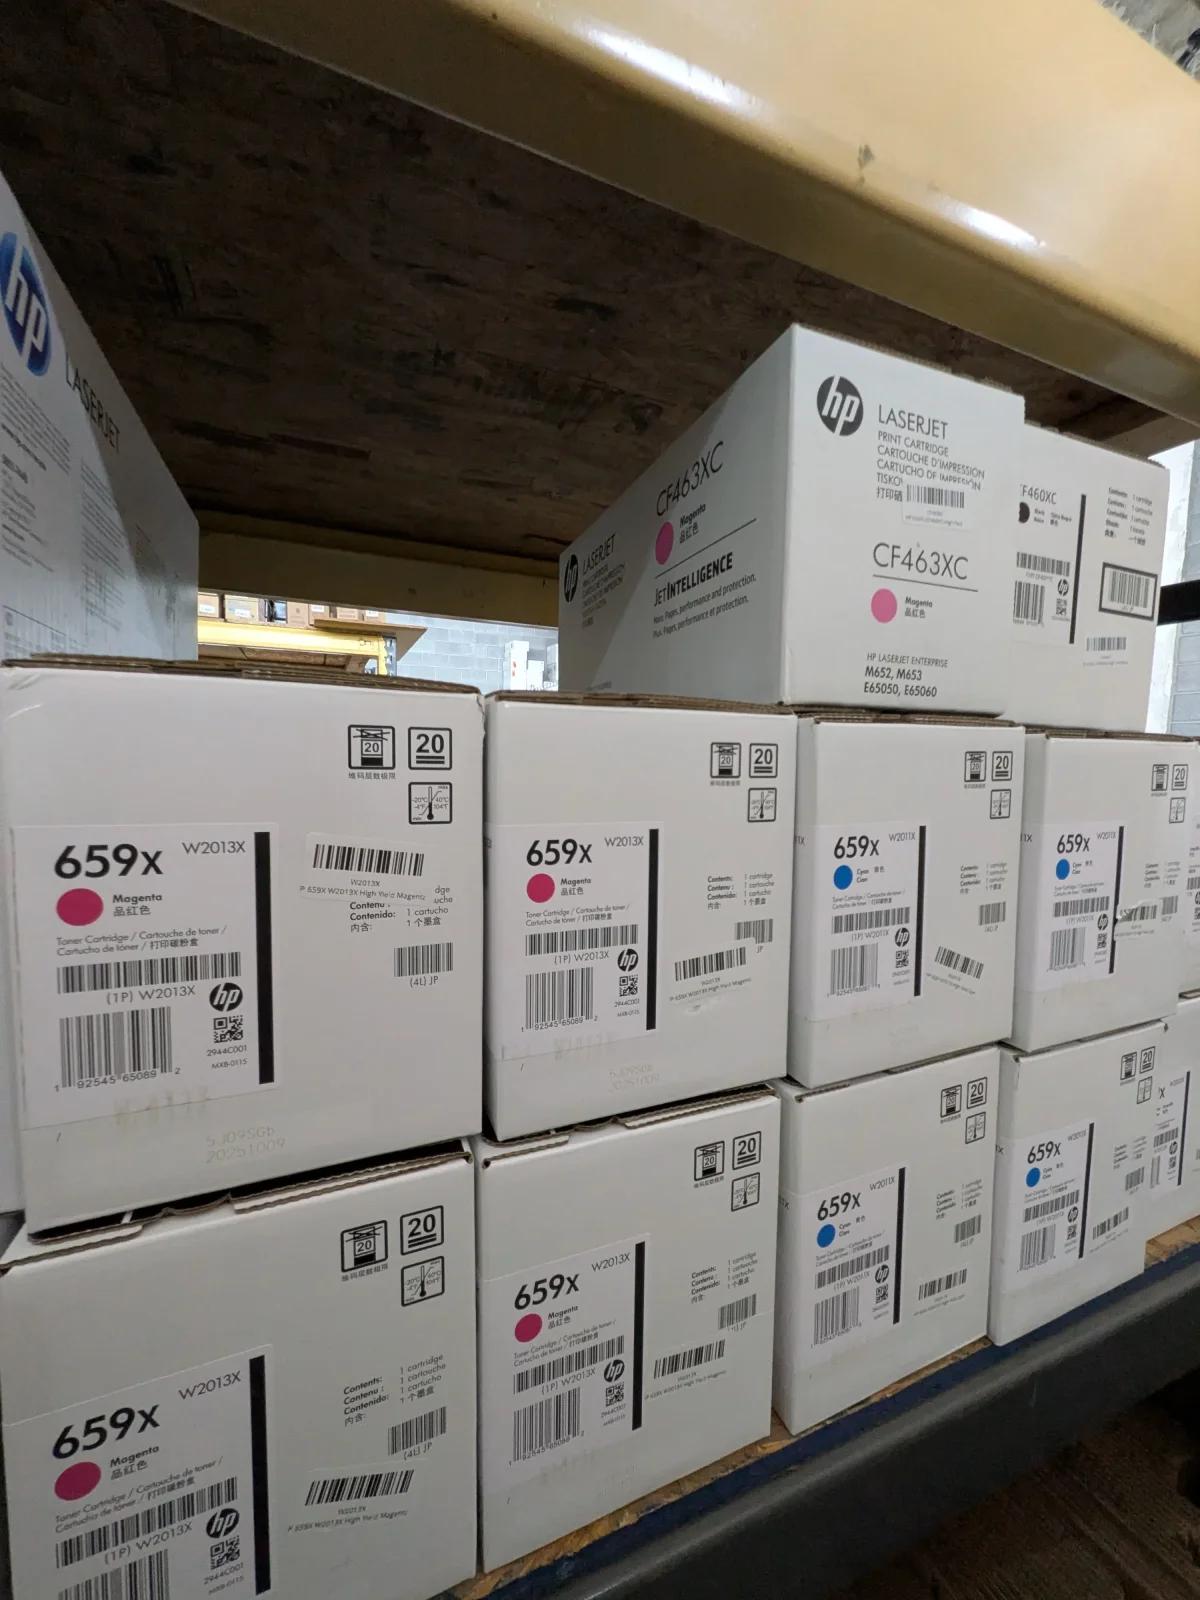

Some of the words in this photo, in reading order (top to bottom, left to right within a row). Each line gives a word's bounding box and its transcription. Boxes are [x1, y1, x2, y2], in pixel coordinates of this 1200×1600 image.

[65, 350, 121, 454] LASERJET
[816, 375, 864, 436] hp
[878, 403, 949, 441] LASERJET
[878, 430, 902, 446] PRINT
[903, 436, 949, 458] CARTRIDGE
[876, 458, 924, 479] CARTUCHO
[877, 445, 929, 468] CARTOUCHE
[931, 455, 985, 480] D'IMPRESSION
[656, 440, 724, 517] CF463XC
[1020, 484, 1057, 506] F460XC
[679, 502, 706, 528] Magenta
[582, 533, 616, 576] LASERJET
[872, 542, 969, 581] CF463XC
[904, 596, 933, 609] Magenta
[866, 651, 879, 663] HP
[878, 653, 910, 665] LASERJET
[910, 655, 949, 669] ENTERPRISE
[865, 664, 894, 682] M652,
[896, 667, 923, 681] M653
[863, 681, 901, 697] E65050,
[903, 683, 938, 698] E65060
[363, 741, 381, 754] 20
[415, 733, 445, 754] 20
[754, 748, 774, 765] 20
[995, 754, 1009, 770] 20
[1174, 768, 1186, 781] 20
[604, 835, 644, 848] W2013X
[888, 831, 916, 843] W2011X
[181, 840, 247, 855] W2013X
[560, 877, 592, 887] Magenta
[560, 886, 584, 897] 品红色
[112, 893, 163, 907] Magenta
[349, 901, 385, 910] Contenu
[112, 904, 151, 918] 品红色
[349, 910, 396, 921] Contenido:
[414, 906, 449, 916] cartucho
[525, 911, 542, 919] Toner
[542, 909, 570, 918] Cartridge
[575, 906, 604, 916] Cartouche
[56, 936, 83, 947] Toner
[84, 933, 130, 945] Cartridge
[138, 928, 185, 940] Cartouche
[185, 928, 197, 937] de
[198, 926, 220, 936] toner
[894, 927, 911, 948] hp
[56, 945, 101, 957] Cartucho
[102, 944, 115, 954] de
[554, 954, 572, 965] (1P)
[574, 950, 610, 963] W2013X
[617, 948, 639, 972] hp
[428, 975, 439, 986] JP
[106, 990, 135, 1005] (1P)
[139, 985, 197, 1001] W2013X
[209, 982, 244, 1012] hp
[1142, 1049, 1153, 1064] 20
[76, 1076, 117, 1089] 92545
[122, 1069, 158, 1083] 65089
[174, 1066, 181, 1076] 2
[971, 1082, 984, 1098] 20
[737, 1137, 757, 1157] 20
[704, 1155, 716, 1166] 20
[869, 1175, 897, 1192] W2011X
[407, 1214, 436, 1239] 20
[356, 1239, 373, 1253] 20
[591, 1252, 631, 1273] W2013X
[874, 1263, 890, 1285] hp
[547, 1304, 579, 1321] Magenta
[406, 1353, 444, 1373] cartridge
[406, 1362, 447, 1383] cartouche
[603, 1358, 625, 1383] hp
[178, 1370, 242, 1401] W2013X
[343, 1375, 384, 1396] Contents:
[406, 1373, 443, 1393] cartucho
[561, 1367, 597, 1387] W2013X
[343, 1388, 379, 1405] Contenu
[343, 1394, 391, 1415] Contenido:
[110, 1445, 160, 1468] Magenta
[110, 1459, 149, 1481] 品红色
[55, 1510, 82, 1524] Toner
[135, 1472, 181, 1494] Cartouche
[181, 1467, 194, 1479] de
[194, 1459, 216, 1472] toner
[206, 1507, 240, 1539] hp
[103, 1546, 131, 1565] (1P)
[135, 1521, 193, 1551] W2013X
